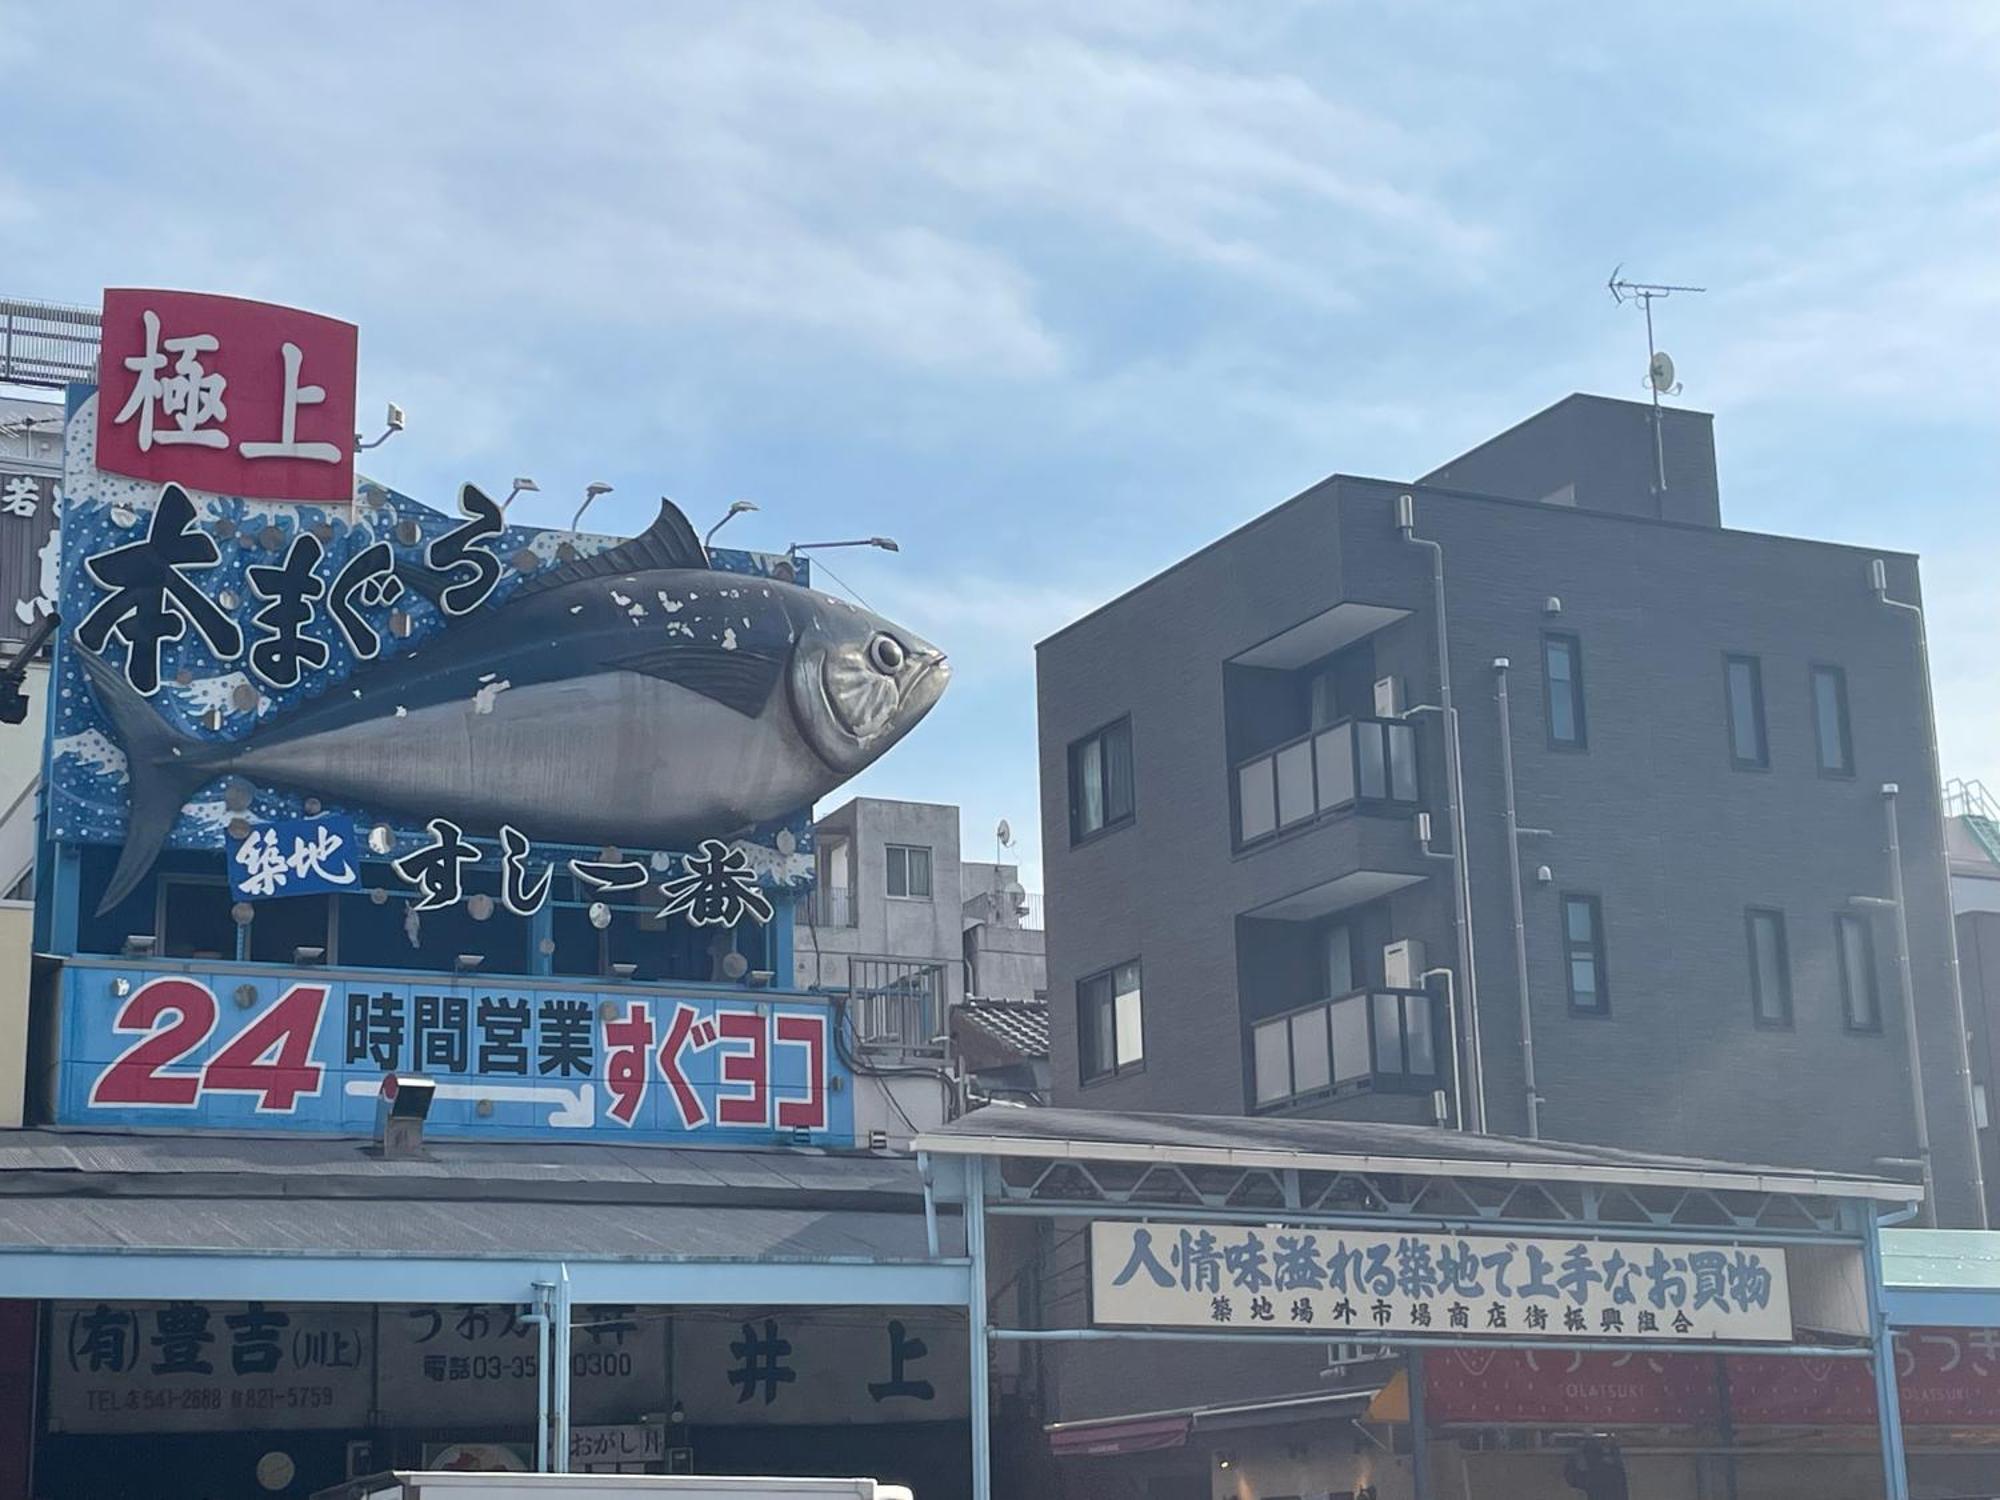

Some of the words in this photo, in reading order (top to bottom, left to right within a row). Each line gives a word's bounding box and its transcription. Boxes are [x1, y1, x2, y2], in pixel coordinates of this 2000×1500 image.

[114, 309, 342, 464] 極上
[74, 481, 502, 696] 本まぐろ
[235, 824, 357, 893] 築地
[396, 817, 775, 928] すし一番
[1112, 1228, 1771, 1314] 人情味溢れる築地で上手なお買物
